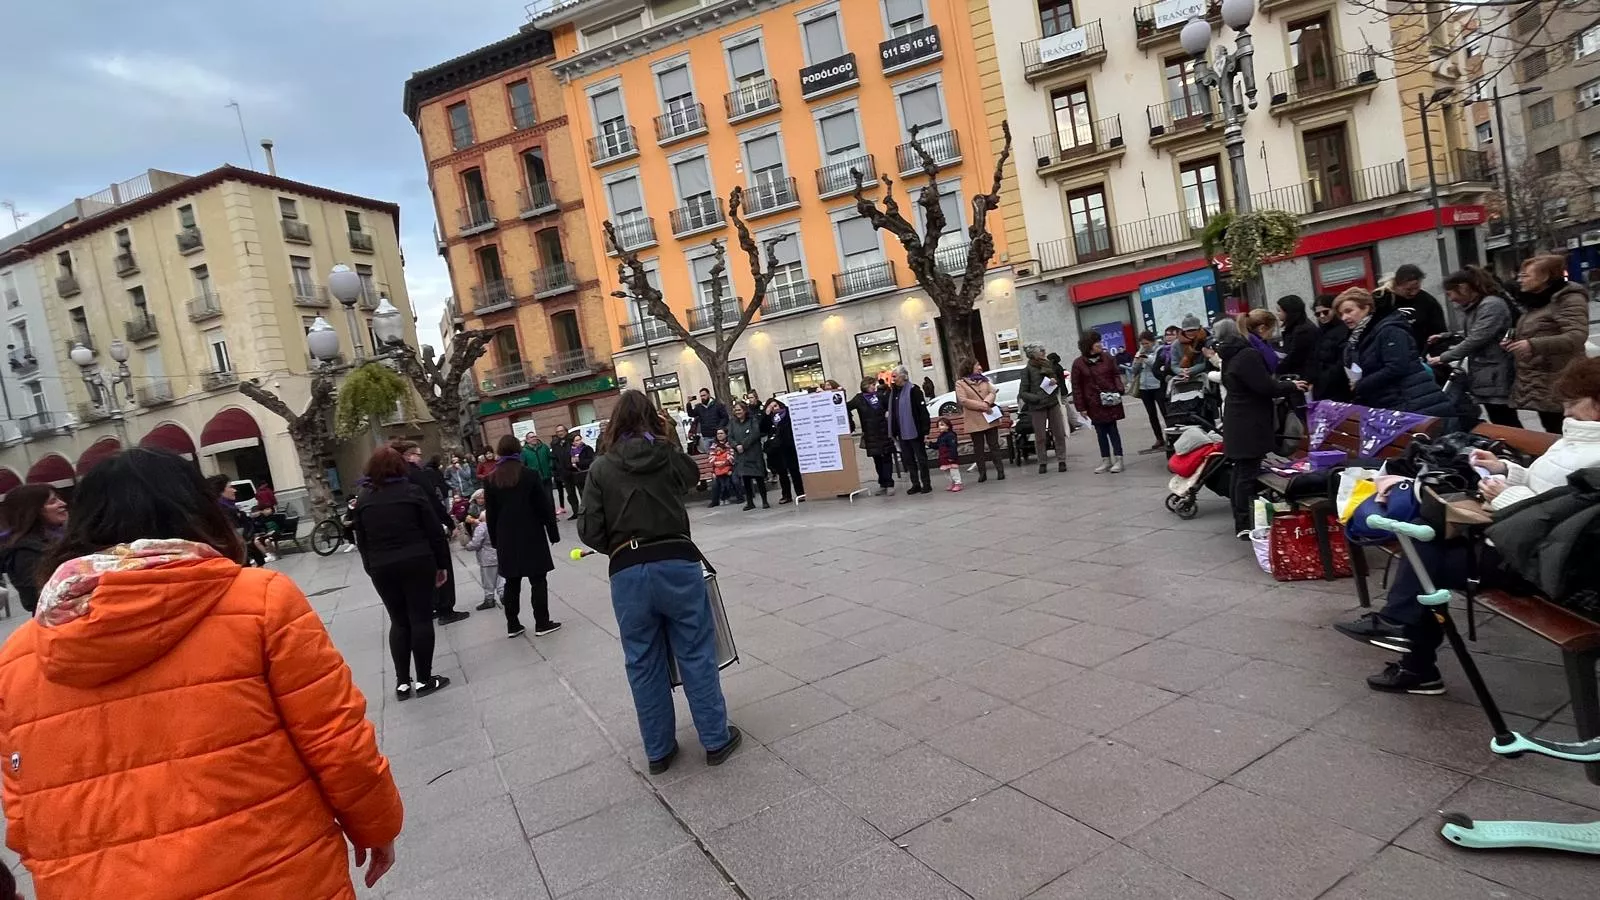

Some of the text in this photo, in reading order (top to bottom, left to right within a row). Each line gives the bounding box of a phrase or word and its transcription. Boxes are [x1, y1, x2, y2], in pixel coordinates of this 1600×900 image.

[882, 47, 898, 59] 611
[900, 43, 911, 54] 59
[913, 39, 924, 49] 16
[925, 34, 936, 44] 16
[802, 62, 853, 84] PODÓLOGO
[1144, 280, 1176, 294] HUESCA
